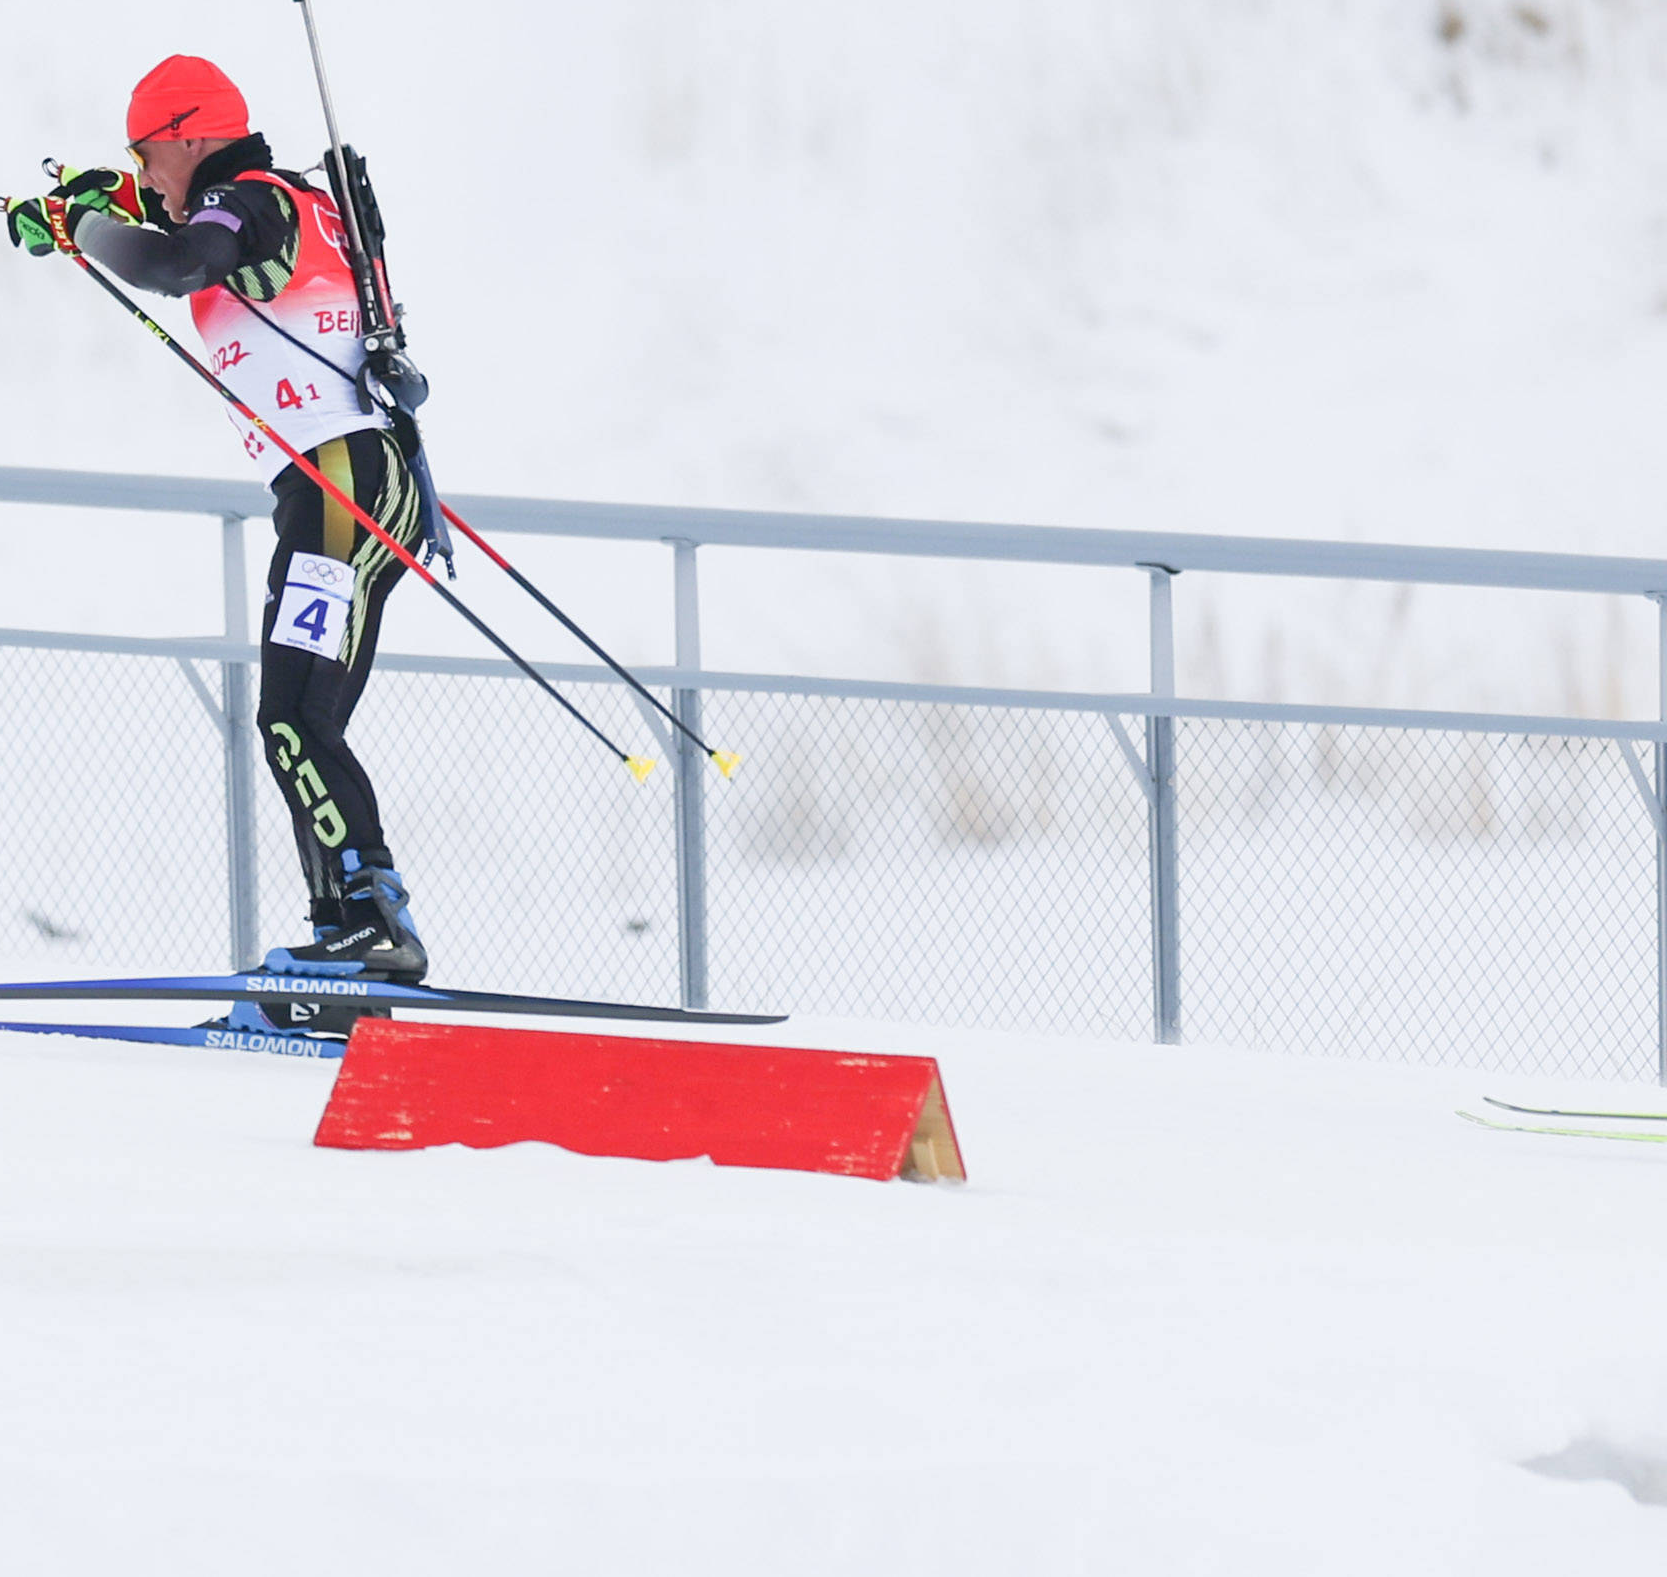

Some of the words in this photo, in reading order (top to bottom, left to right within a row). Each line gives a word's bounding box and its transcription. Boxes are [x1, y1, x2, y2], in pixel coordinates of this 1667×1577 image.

[135, 310, 170, 343] LEKI
[314, 310, 363, 339] BEIJ
[210, 340, 252, 375] 022
[275, 378, 303, 410] 4
[292, 598, 329, 642] 4
[245, 976, 368, 996] SALOMON
[205, 1030, 323, 1058] SALOMON
